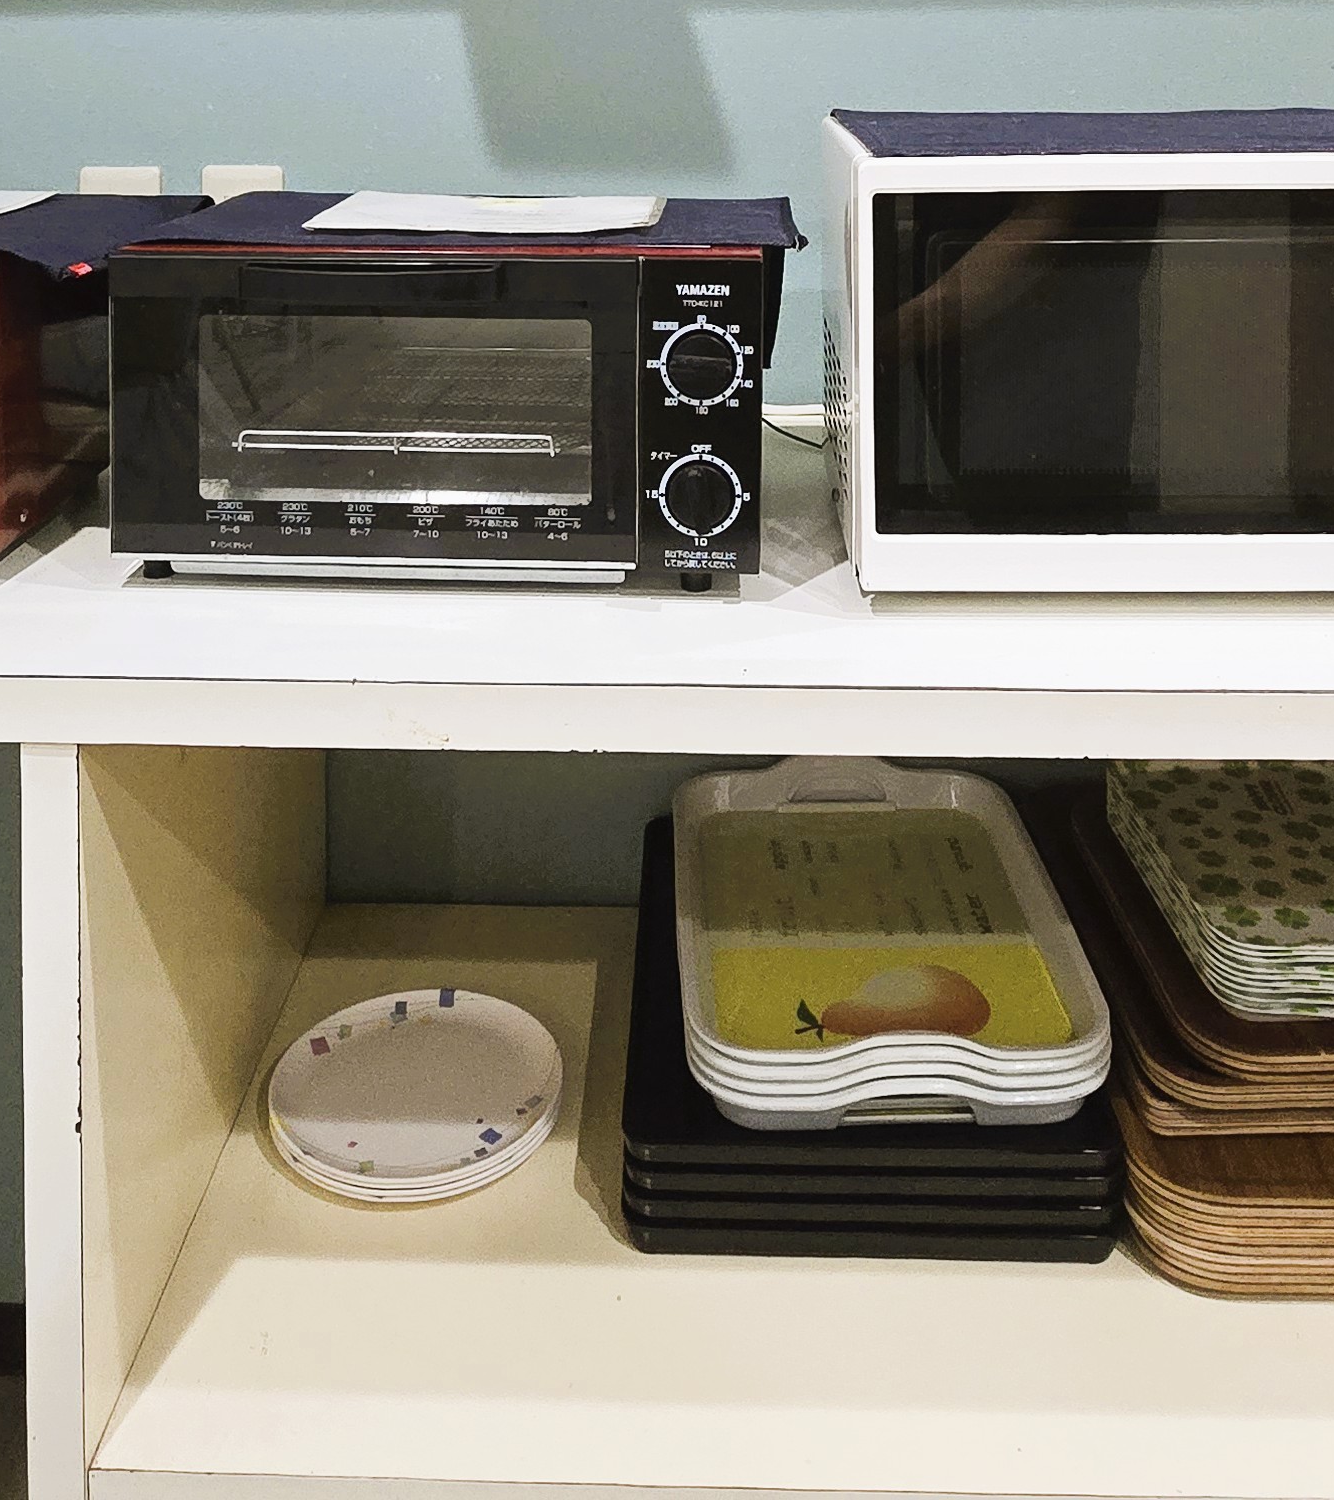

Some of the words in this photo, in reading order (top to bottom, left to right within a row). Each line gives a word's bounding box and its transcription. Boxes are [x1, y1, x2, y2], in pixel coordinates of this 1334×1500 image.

[676, 284, 730, 296] YAMAZEN
[691, 444, 712, 453] OFF
[650, 451, 678, 460] タイマー
[646, 489, 659, 499] 15
[743, 492, 751, 501] 5
[280, 515, 311, 523] グラタン
[348, 516, 372, 525] おもち
[417, 518, 433, 526] ピザ
[465, 518, 519, 528] フライあたため
[534, 520, 581, 529] バターロール
[694, 537, 708, 547] 10
